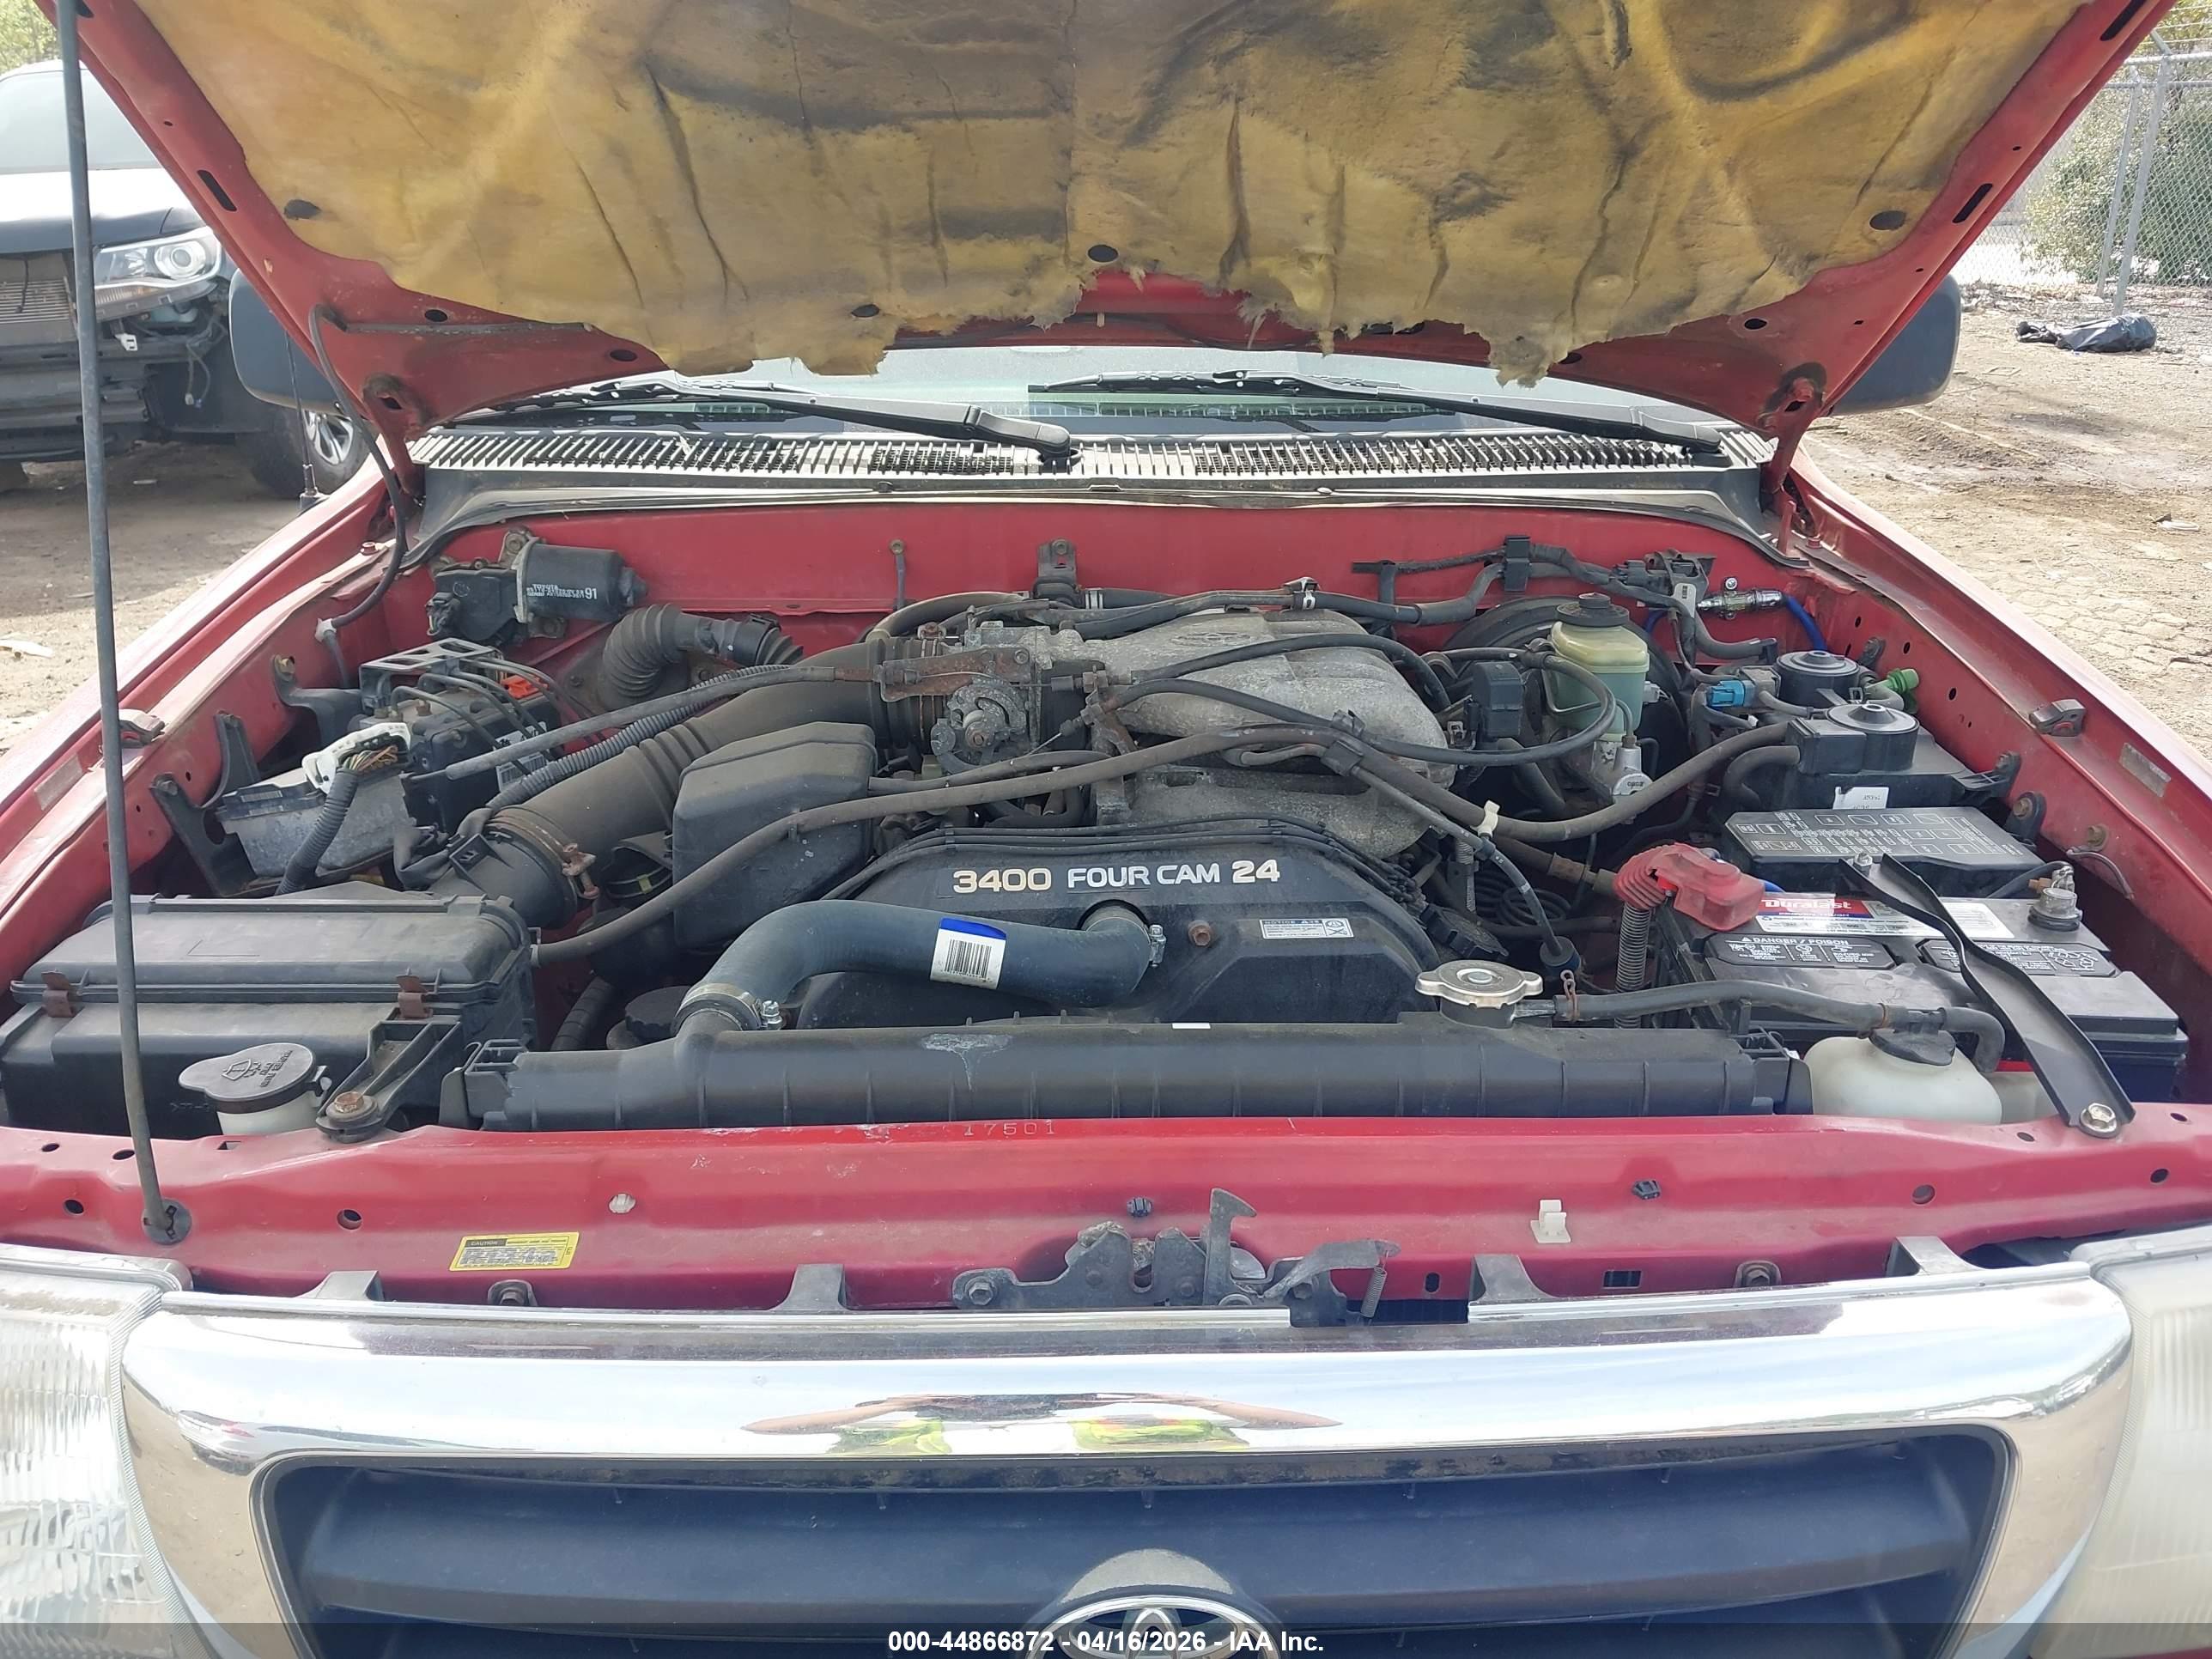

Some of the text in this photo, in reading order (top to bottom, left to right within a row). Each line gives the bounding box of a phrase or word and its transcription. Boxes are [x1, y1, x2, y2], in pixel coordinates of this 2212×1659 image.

[585, 587, 598, 599] 91
[953, 859, 1280, 894] 3400 FOUR CAM 24
[1761, 898, 1852, 909] Duralast
